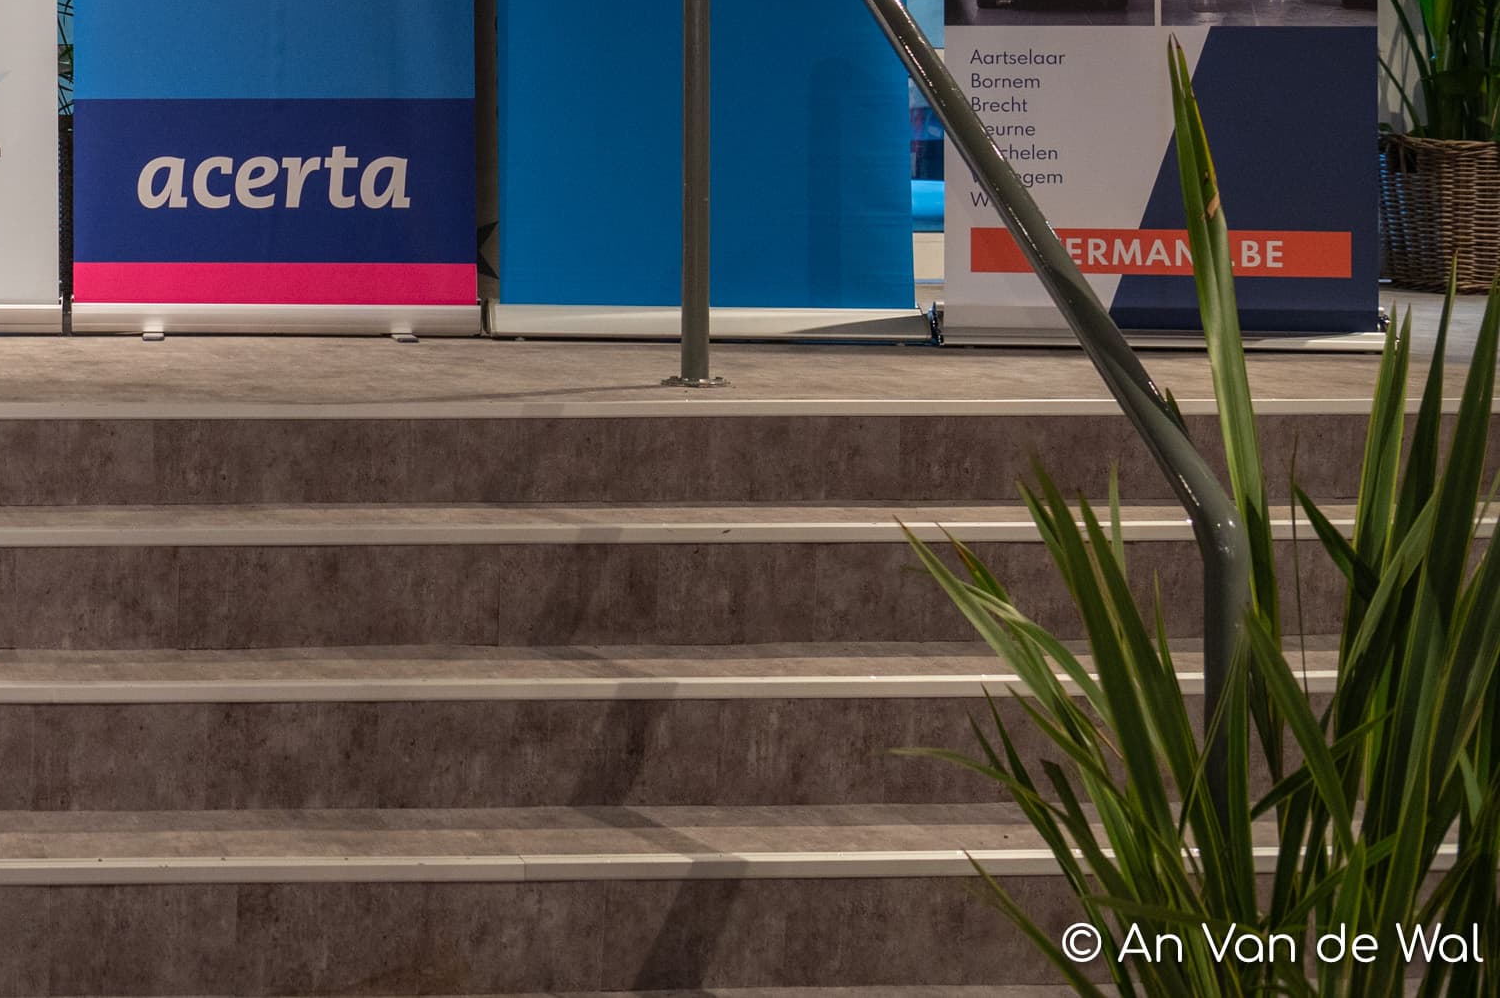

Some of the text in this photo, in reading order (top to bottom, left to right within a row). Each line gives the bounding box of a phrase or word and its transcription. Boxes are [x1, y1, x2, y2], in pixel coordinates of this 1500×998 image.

[970, 49, 1065, 66] Aartselaar
[971, 74, 1040, 89] Bornem
[971, 97, 1028, 113] Brecht
[985, 125, 1036, 136] eurne
[1001, 144, 1058, 160] chelen
[137, 146, 411, 209] acerta
[1065, 238, 1284, 268] ERMAN.BE
